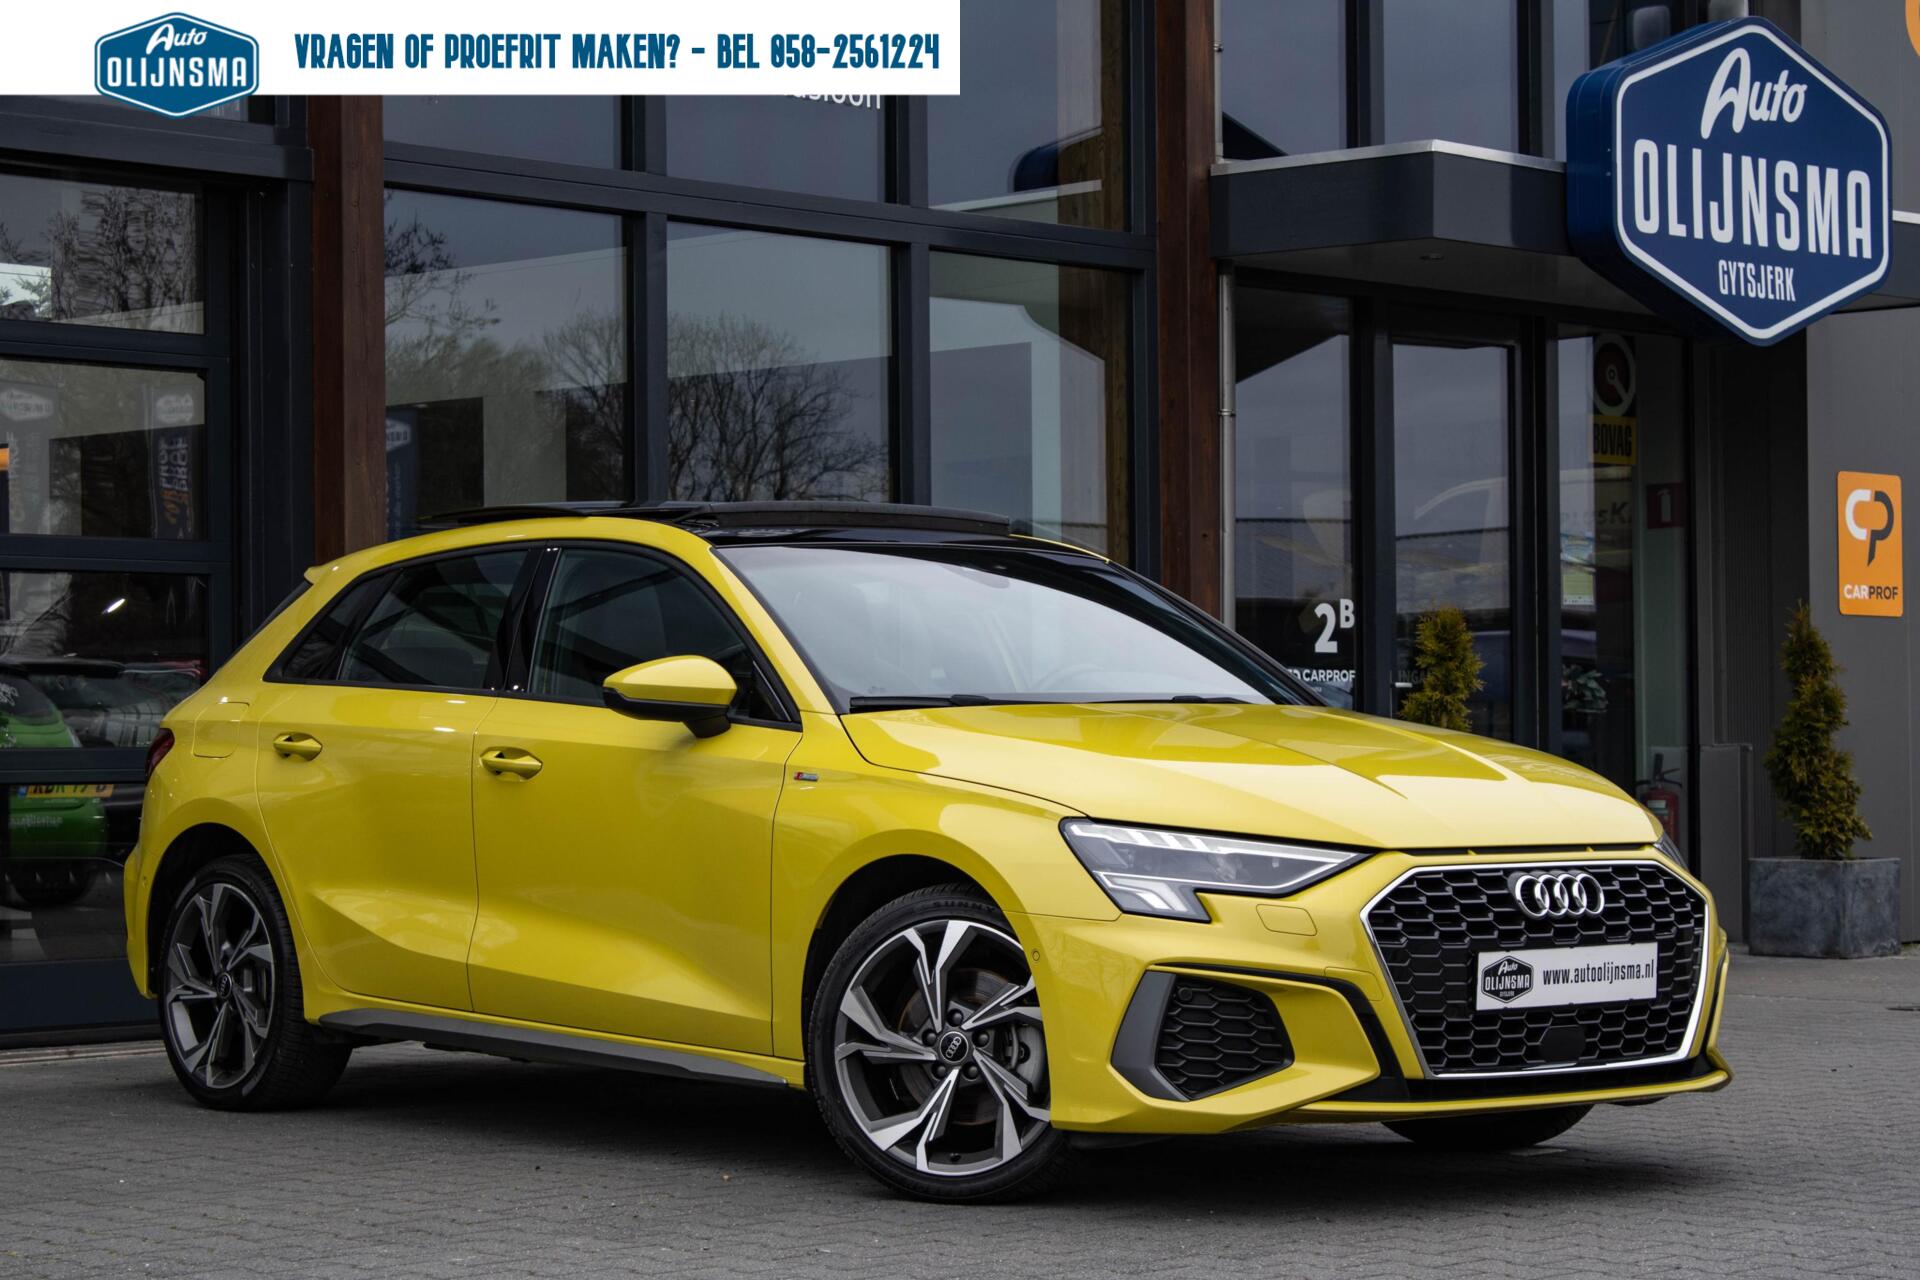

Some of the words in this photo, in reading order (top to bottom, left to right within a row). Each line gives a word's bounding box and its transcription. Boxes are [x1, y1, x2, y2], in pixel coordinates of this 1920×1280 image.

[1700, 47, 1807, 139] Auto
[1633, 138, 1872, 259] OLIJNSMA
[1718, 259, 1796, 302] GYTSJERK
[1843, 584, 1899, 600] CARPROF
[1302, 669, 1356, 682] CARPROF
[1497, 960, 1518, 975] Auto
[1543, 960, 1654, 985] www.autoolijnsma.nl
[1484, 974, 1530, 991] OLIJNSMA
